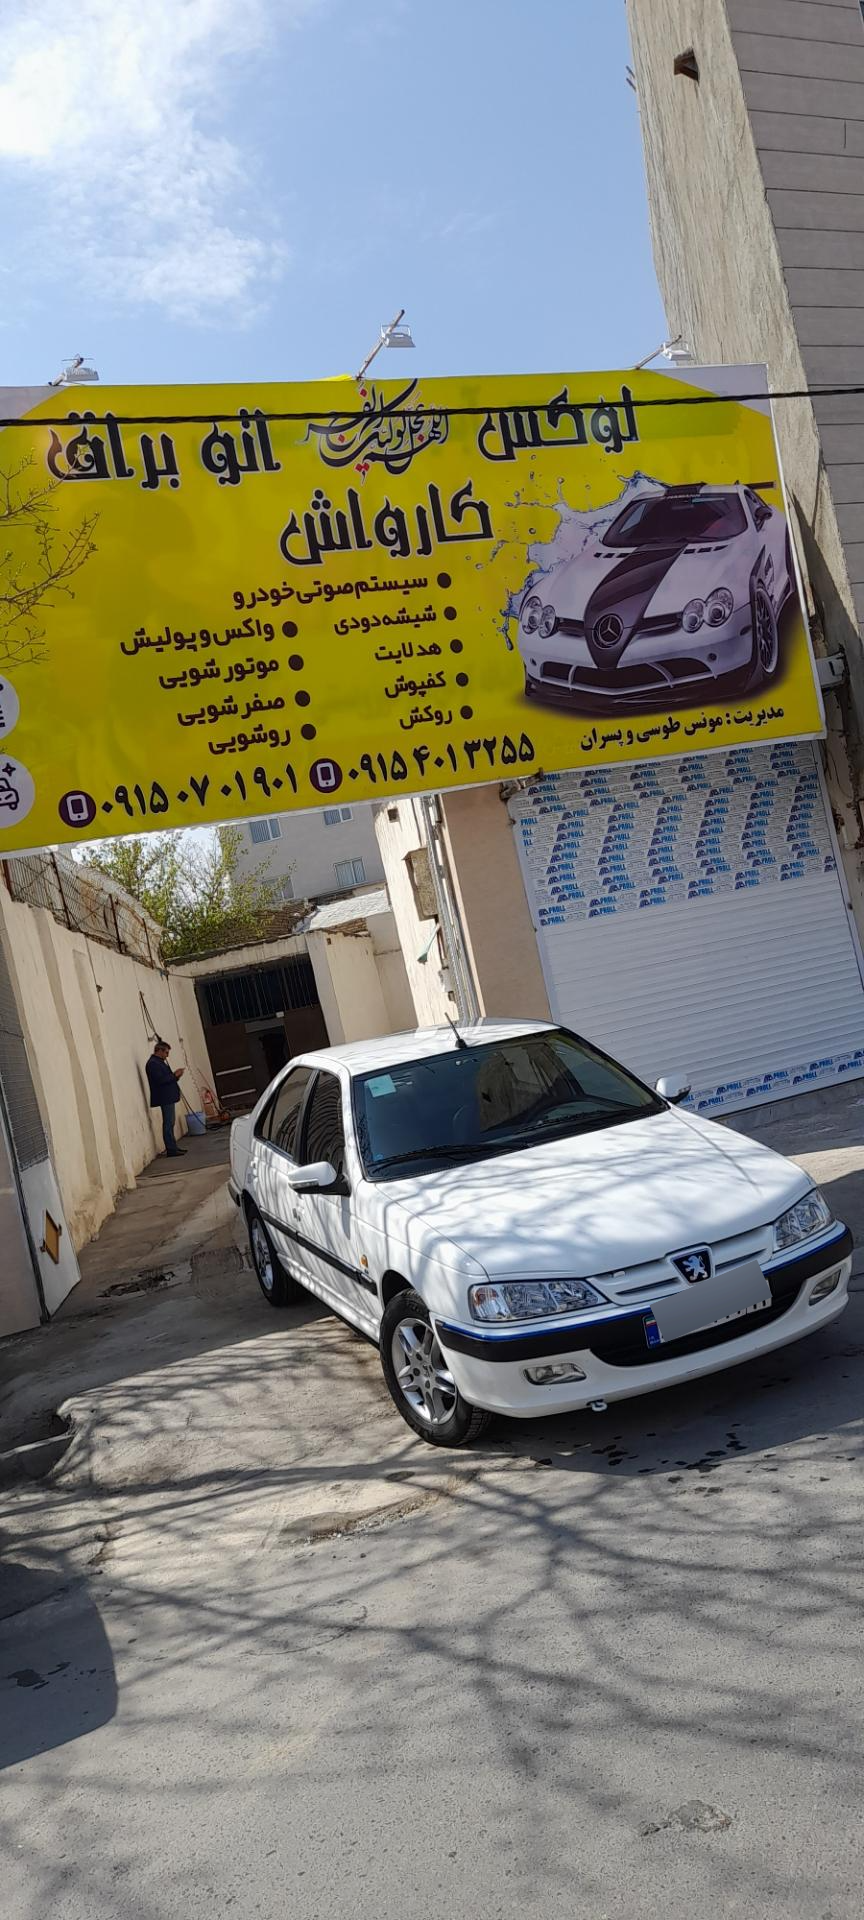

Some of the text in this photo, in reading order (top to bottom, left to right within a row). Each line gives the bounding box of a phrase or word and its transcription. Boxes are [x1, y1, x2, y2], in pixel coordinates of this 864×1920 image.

[477, 383, 640, 462] لوکس
[46, 410, 181, 490] براق
[279, 478, 495, 566] کارواش
[233, 576, 428, 610] سیستم صوتی خودرو
[213, 617, 275, 646] واکس
[334, 605, 437, 635] شیشه دودی
[120, 626, 197, 655] پولیش
[159, 657, 279, 689] موتور شویی
[384, 671, 446, 698] کفپوش
[177, 693, 285, 726] صفر شویی
[400, 704, 452, 730] روکش
[684, 711, 723, 736] مونس
[579, 728, 623, 751] پسران
[636, 716, 681, 742] طوسی
